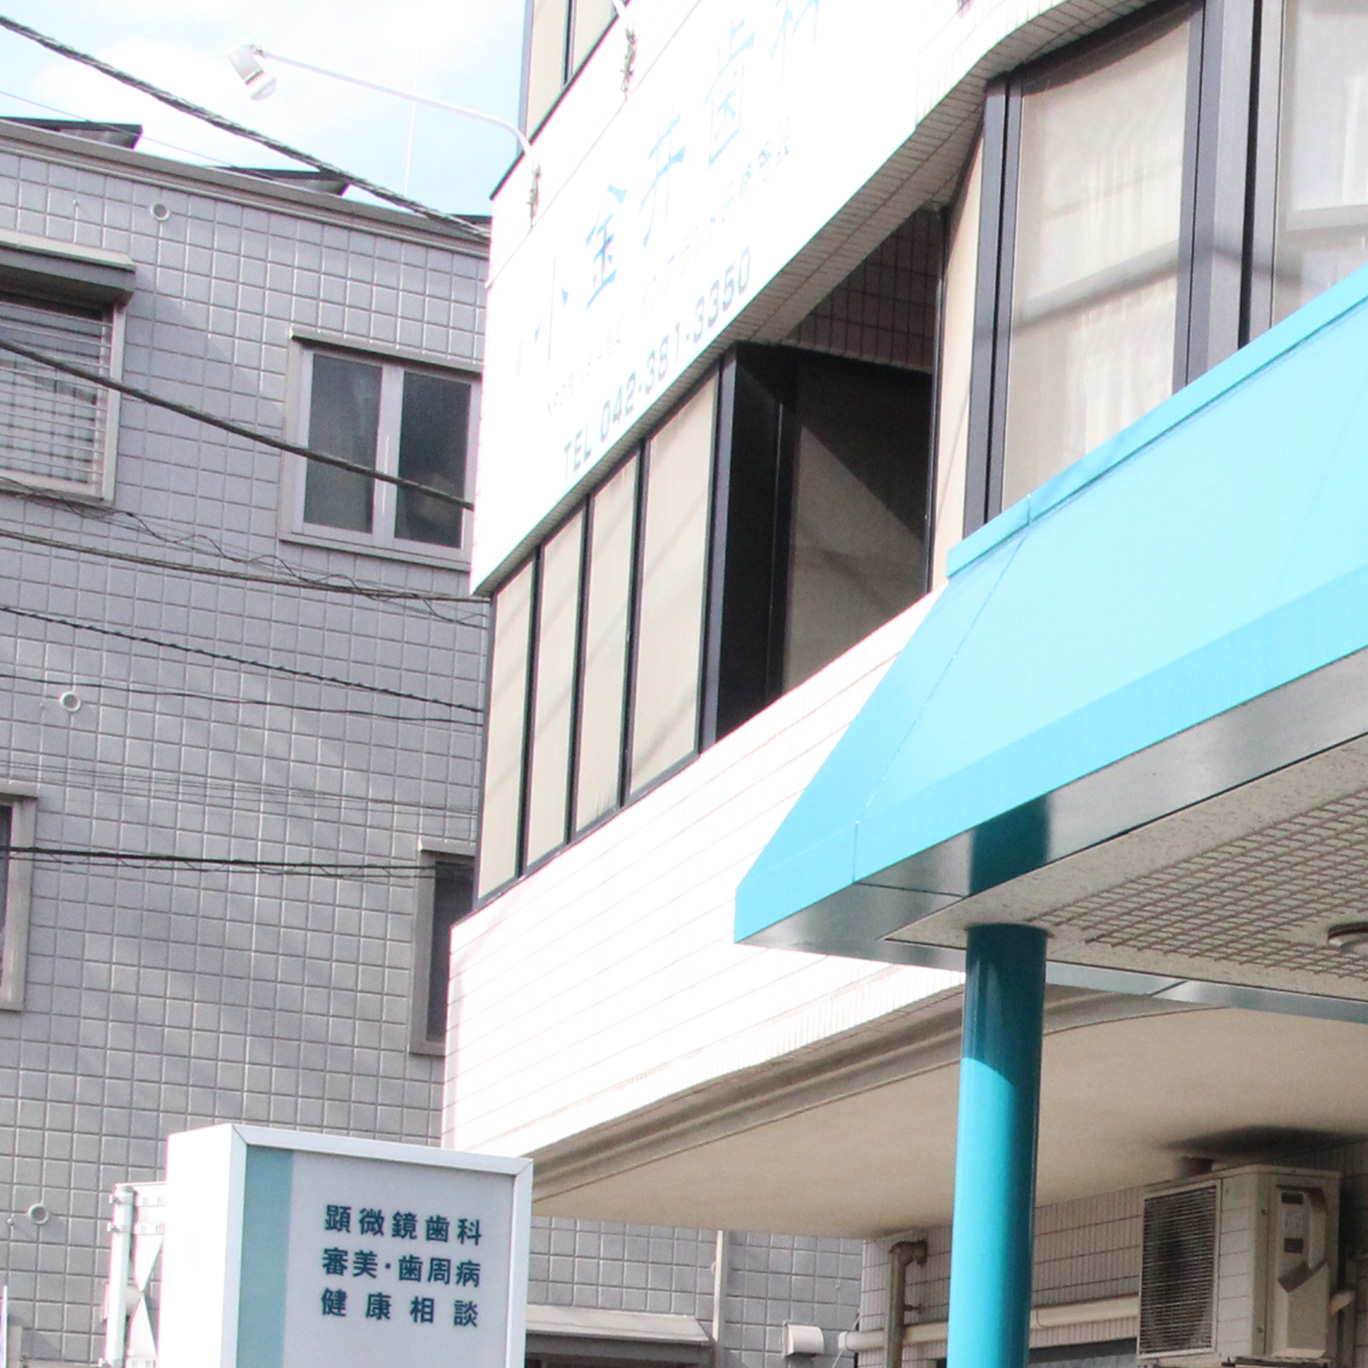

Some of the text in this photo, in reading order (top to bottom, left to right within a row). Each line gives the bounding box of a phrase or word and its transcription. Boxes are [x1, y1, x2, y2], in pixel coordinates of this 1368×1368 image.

[563, 424, 593, 483] TEL
[324, 1204, 482, 1247] 顕微鏡歯科
[320, 1287, 479, 1328] 健康相談
